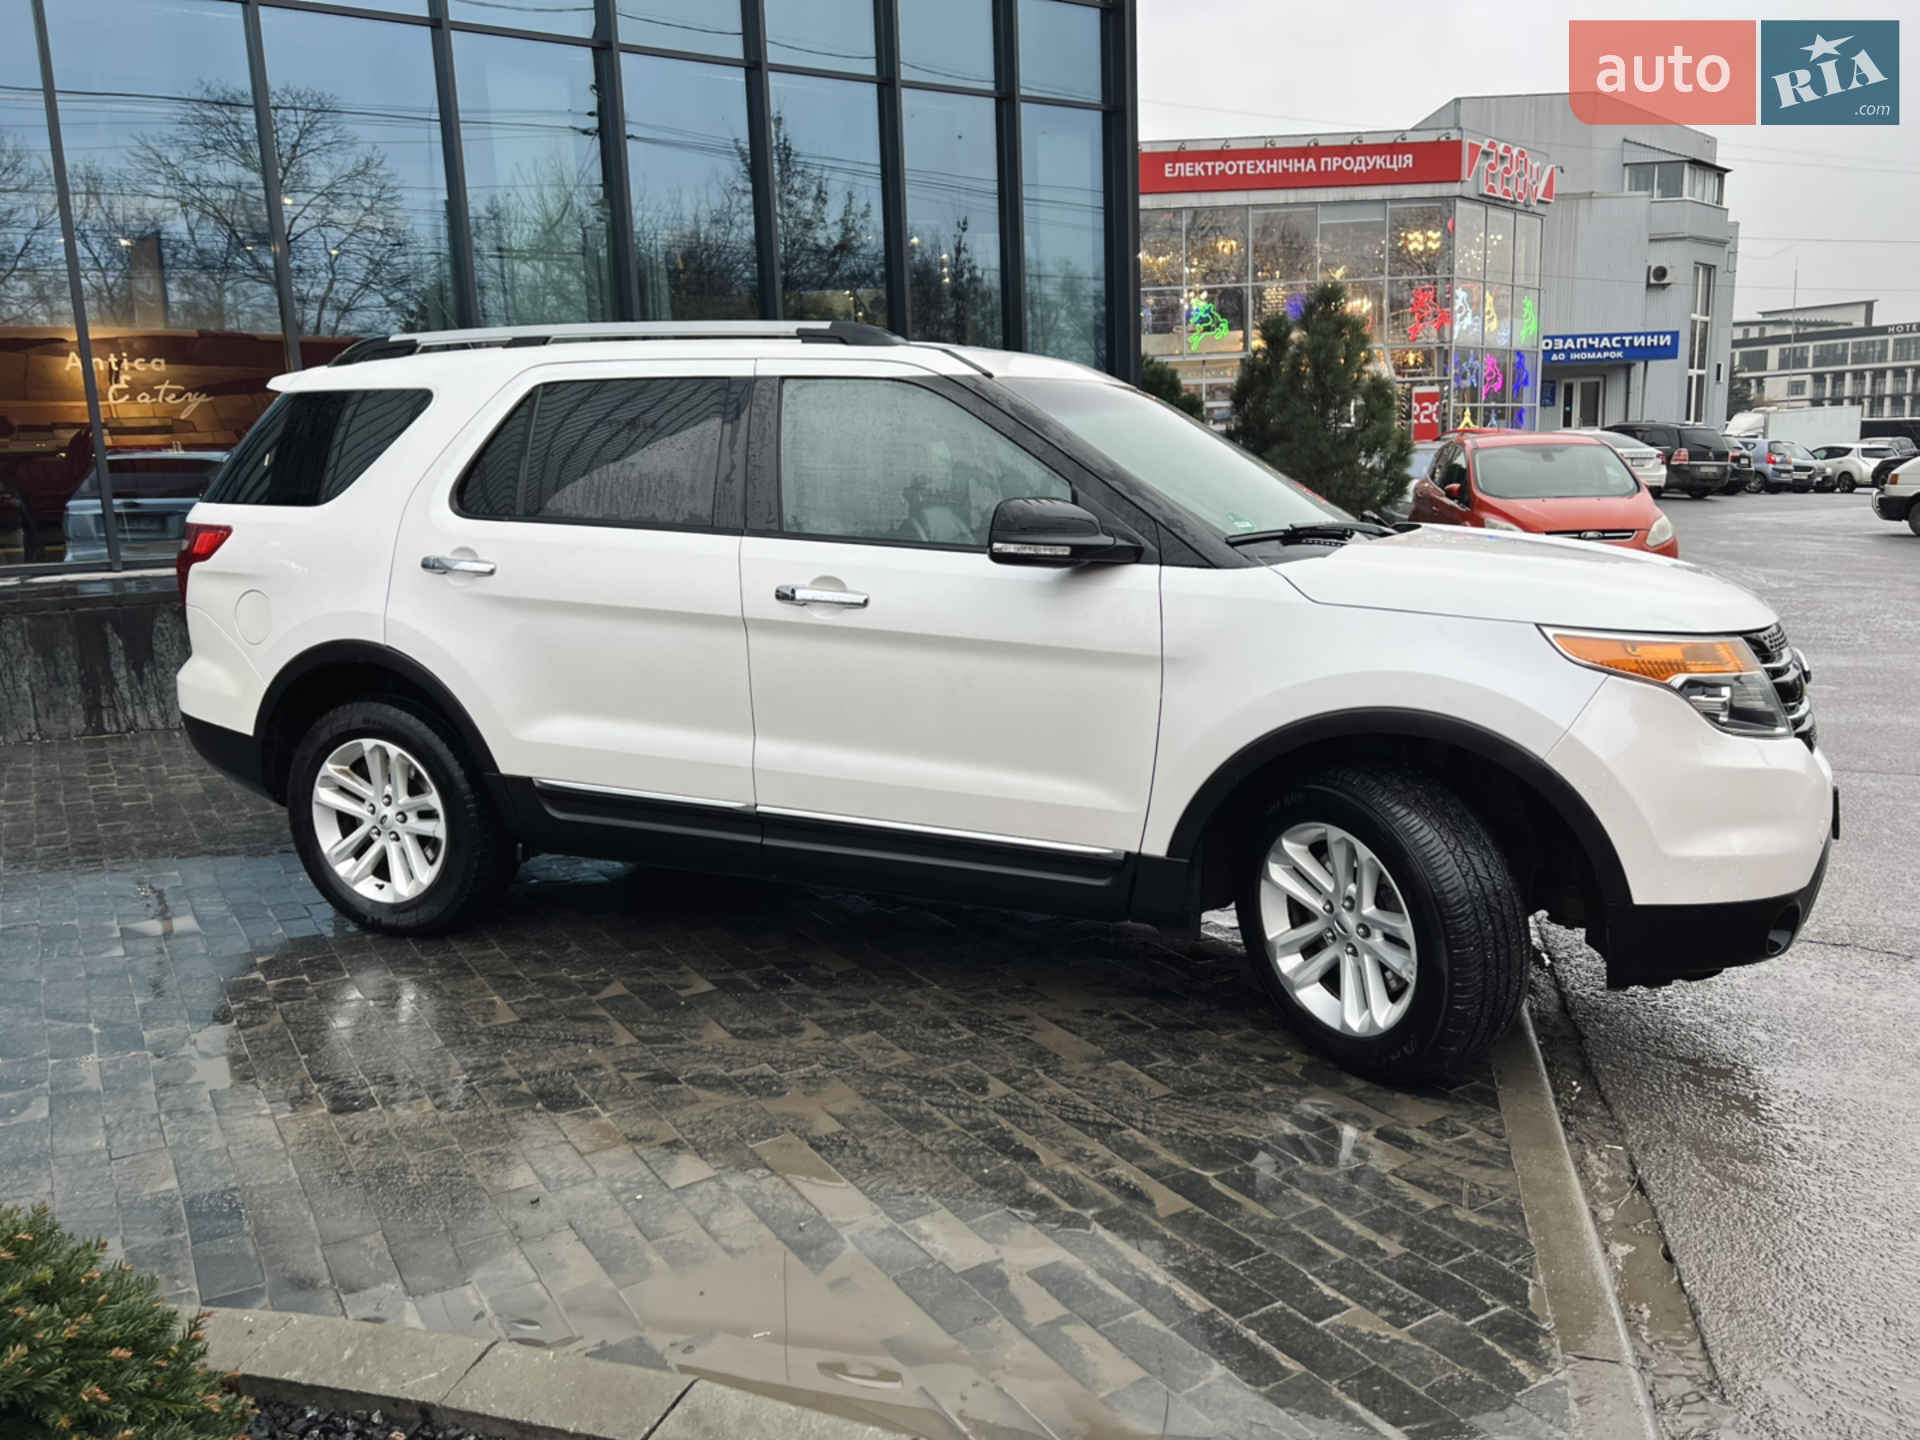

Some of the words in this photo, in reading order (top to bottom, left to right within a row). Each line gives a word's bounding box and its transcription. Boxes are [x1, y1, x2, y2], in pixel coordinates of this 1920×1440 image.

[1164, 157, 1317, 178] ЕЛЕКТРОТЕХНІЧНА
[1320, 153, 1414, 173] ПРОДУКЦІЯ
[1542, 334, 1672, 351] ОЗАПЧАСТИНИ
[65, 351, 166, 371] Antica
[1551, 352, 1566, 361] ДО
[1570, 351, 1624, 361] ІНОМАРОК
[108, 374, 214, 419] Eatery
